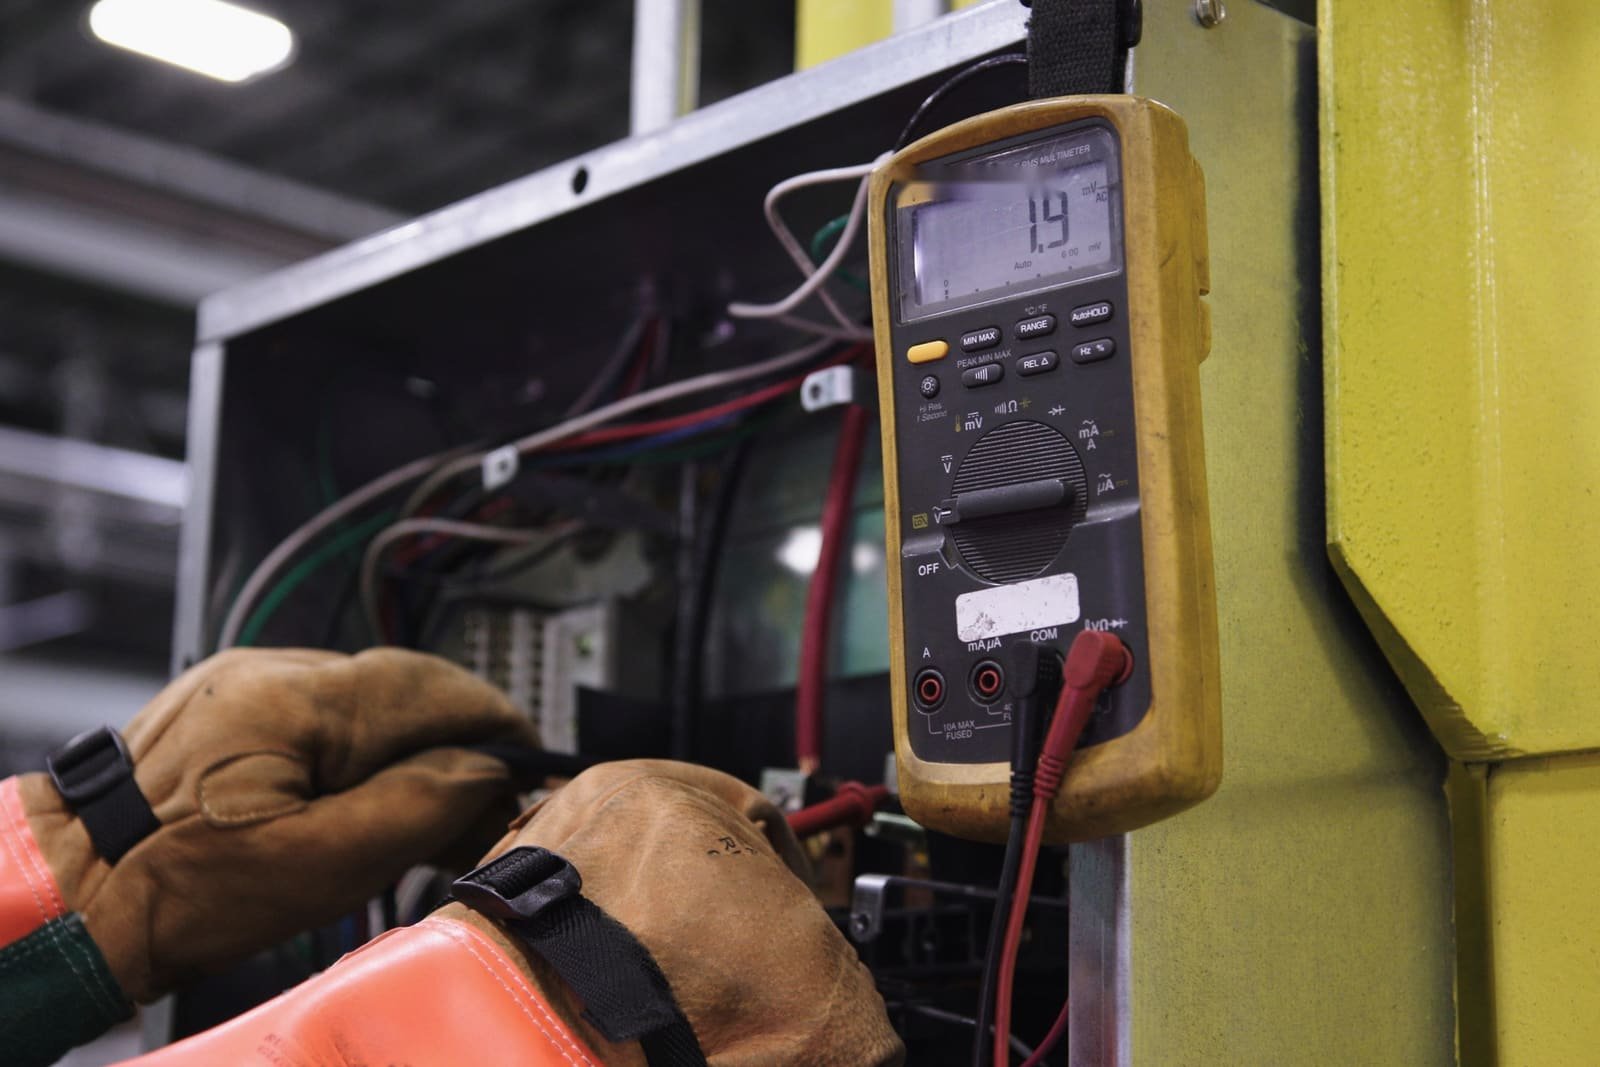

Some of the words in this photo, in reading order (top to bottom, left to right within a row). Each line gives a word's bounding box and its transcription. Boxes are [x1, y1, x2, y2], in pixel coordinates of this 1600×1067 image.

[1040, 144, 1091, 163] MULTIMETER
[1014, 260, 1033, 271] Auto
[1072, 306, 1109, 322] AutoHOLD
[1020, 320, 1048, 333] RANGE
[963, 335, 978, 346] MIN
[978, 331, 996, 344] MAX
[1080, 345, 1091, 356] Hz
[957, 357, 978, 369] PEAK
[979, 354, 993, 365] MIN
[993, 350, 1012, 362] MAX
[1023, 359, 1039, 370] REL
[921, 410, 947, 422] Second
[964, 416, 983, 432] mV
[1079, 424, 1099, 438] mA
[1087, 439, 1096, 450] A
[918, 563, 939, 576] OFF
[1030, 628, 1058, 642] COM
[922, 647, 931, 658] A
[958, 720, 975, 730] MAX
[946, 729, 973, 741] FUSED
